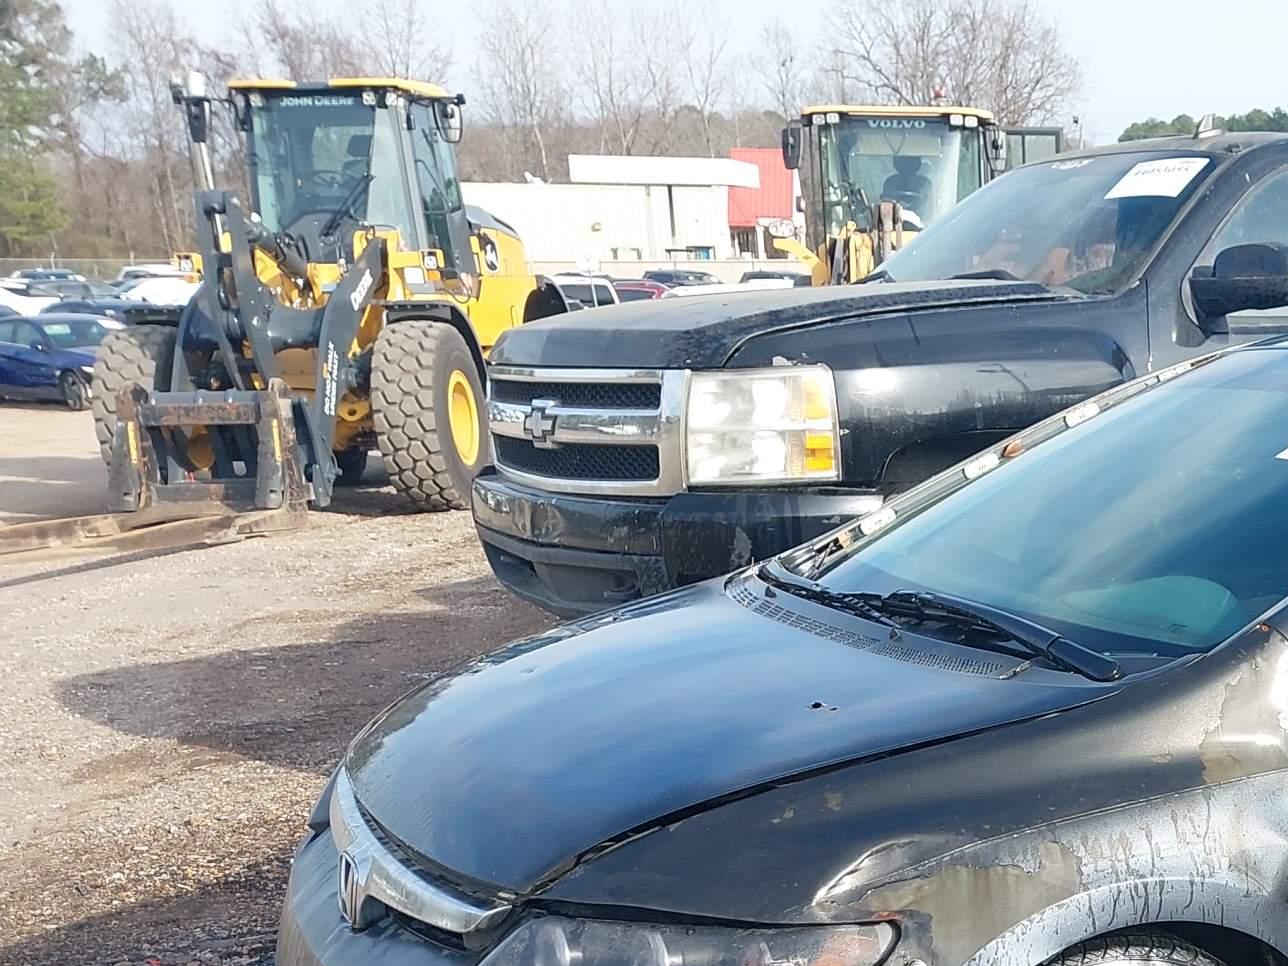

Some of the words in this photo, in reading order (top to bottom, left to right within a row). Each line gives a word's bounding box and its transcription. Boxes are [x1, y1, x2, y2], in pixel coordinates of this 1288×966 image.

[280, 96, 312, 106] JOHN
[314, 95, 355, 106] DEERE
[867, 119, 926, 129] VOLVO
